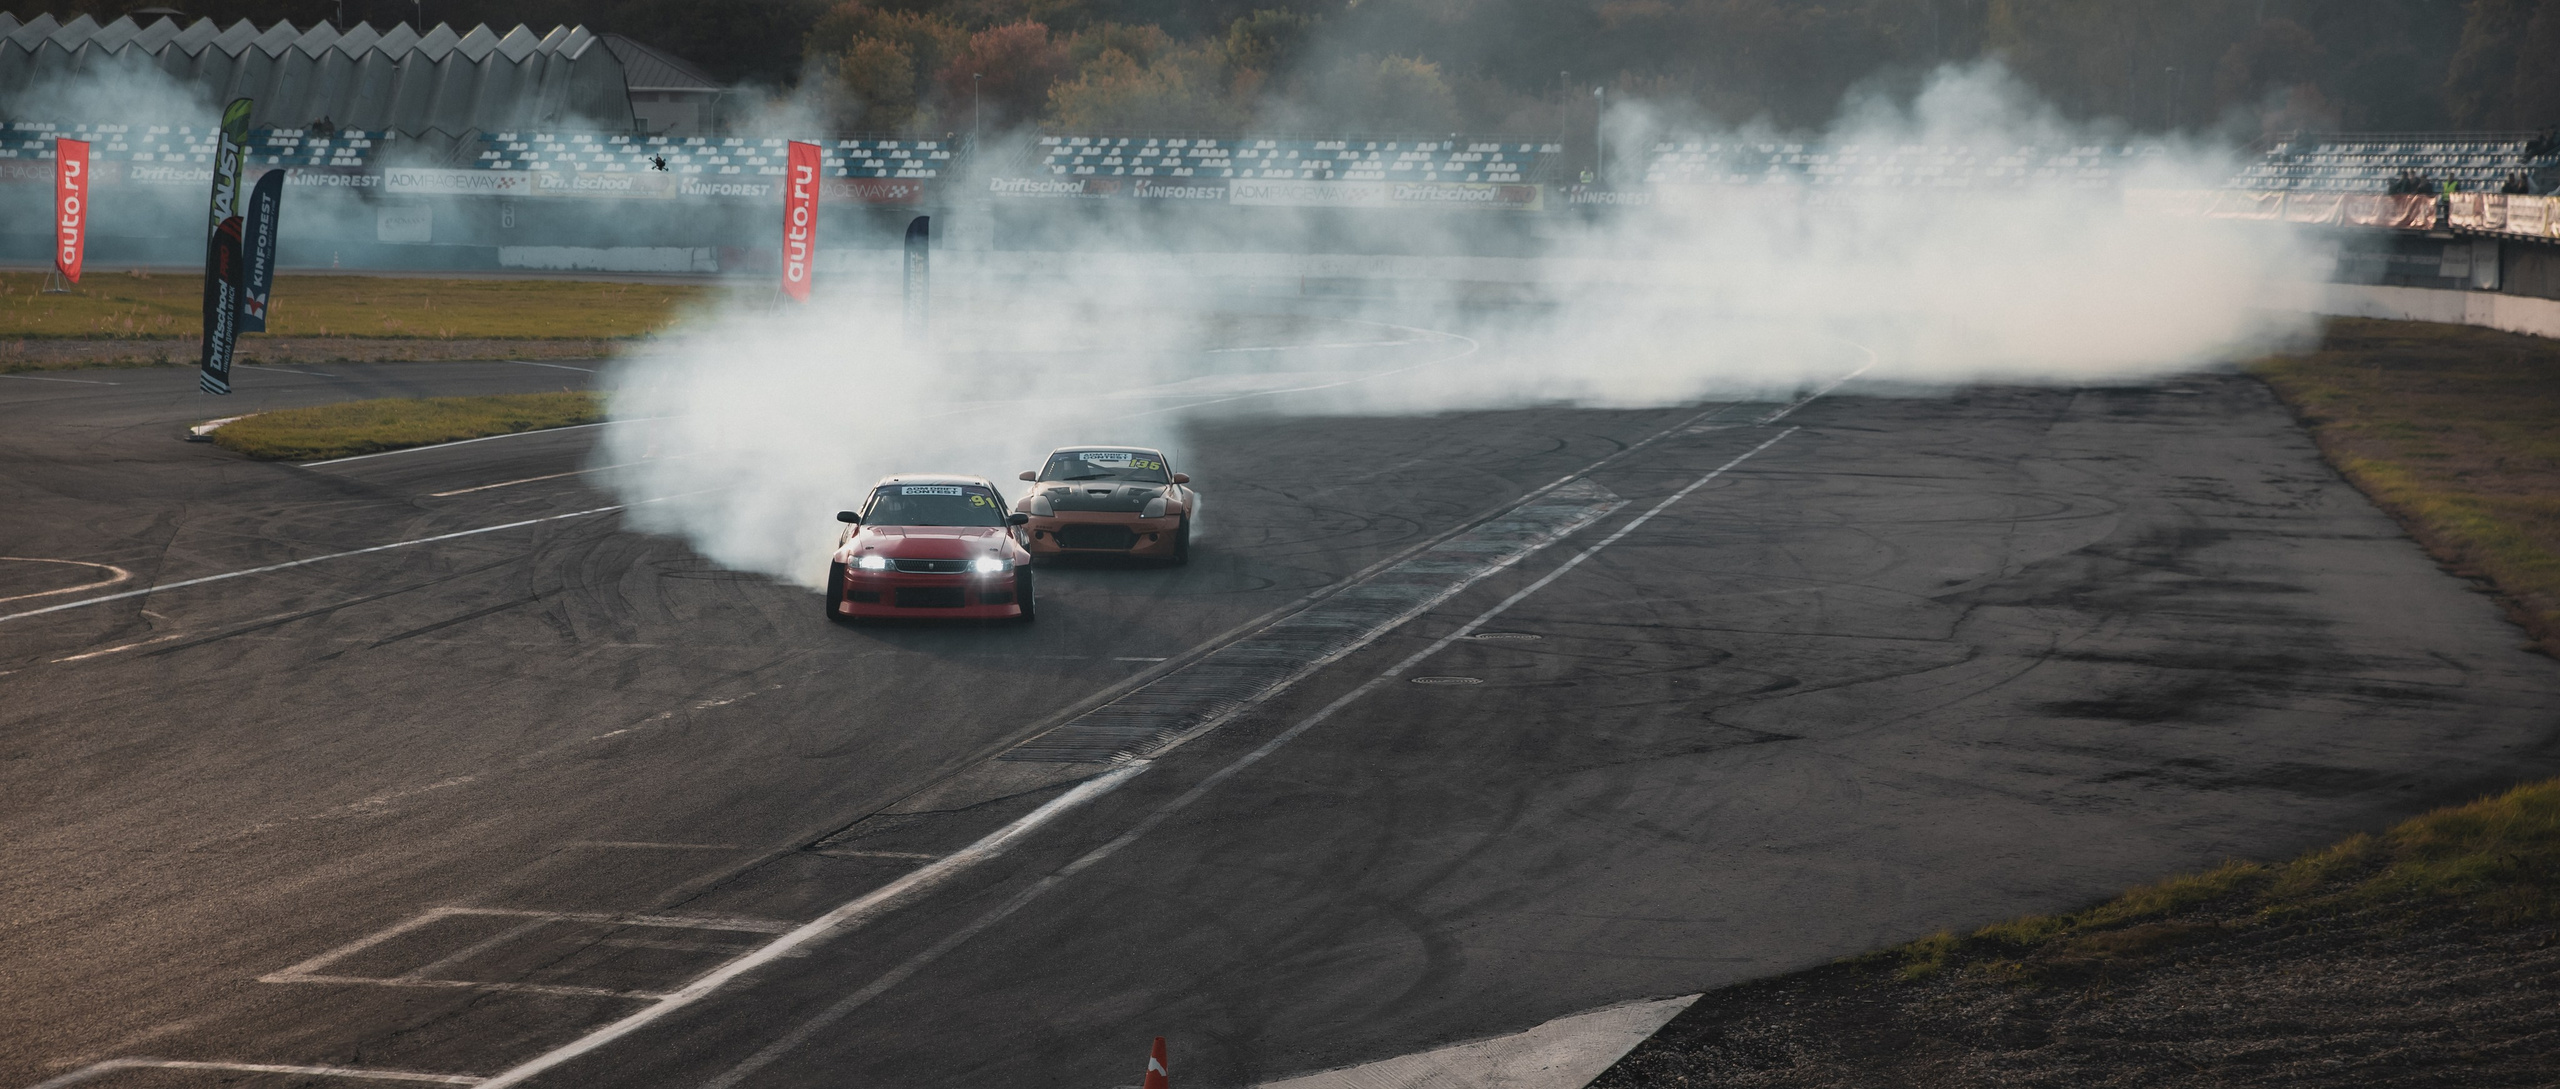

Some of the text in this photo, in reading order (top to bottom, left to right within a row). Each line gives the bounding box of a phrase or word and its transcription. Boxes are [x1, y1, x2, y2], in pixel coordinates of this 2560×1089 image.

[213, 132, 239, 236] HAUST
[284, 168, 381, 187] KINFOREST
[390, 174, 498, 189] ADMRACEWAY
[681, 178, 770, 196] KINFOREST
[1133, 180, 1226, 199] KINFOREST
[62, 160, 80, 265] auto.ru
[788, 165, 812, 282] auto.ru
[254, 192, 271, 287] KINFOREST
[228, 286, 236, 303] МСК
[226, 311, 234, 344] ДРИФТА
[1129, 459, 1161, 471] 135
[971, 495, 996, 509] 91
